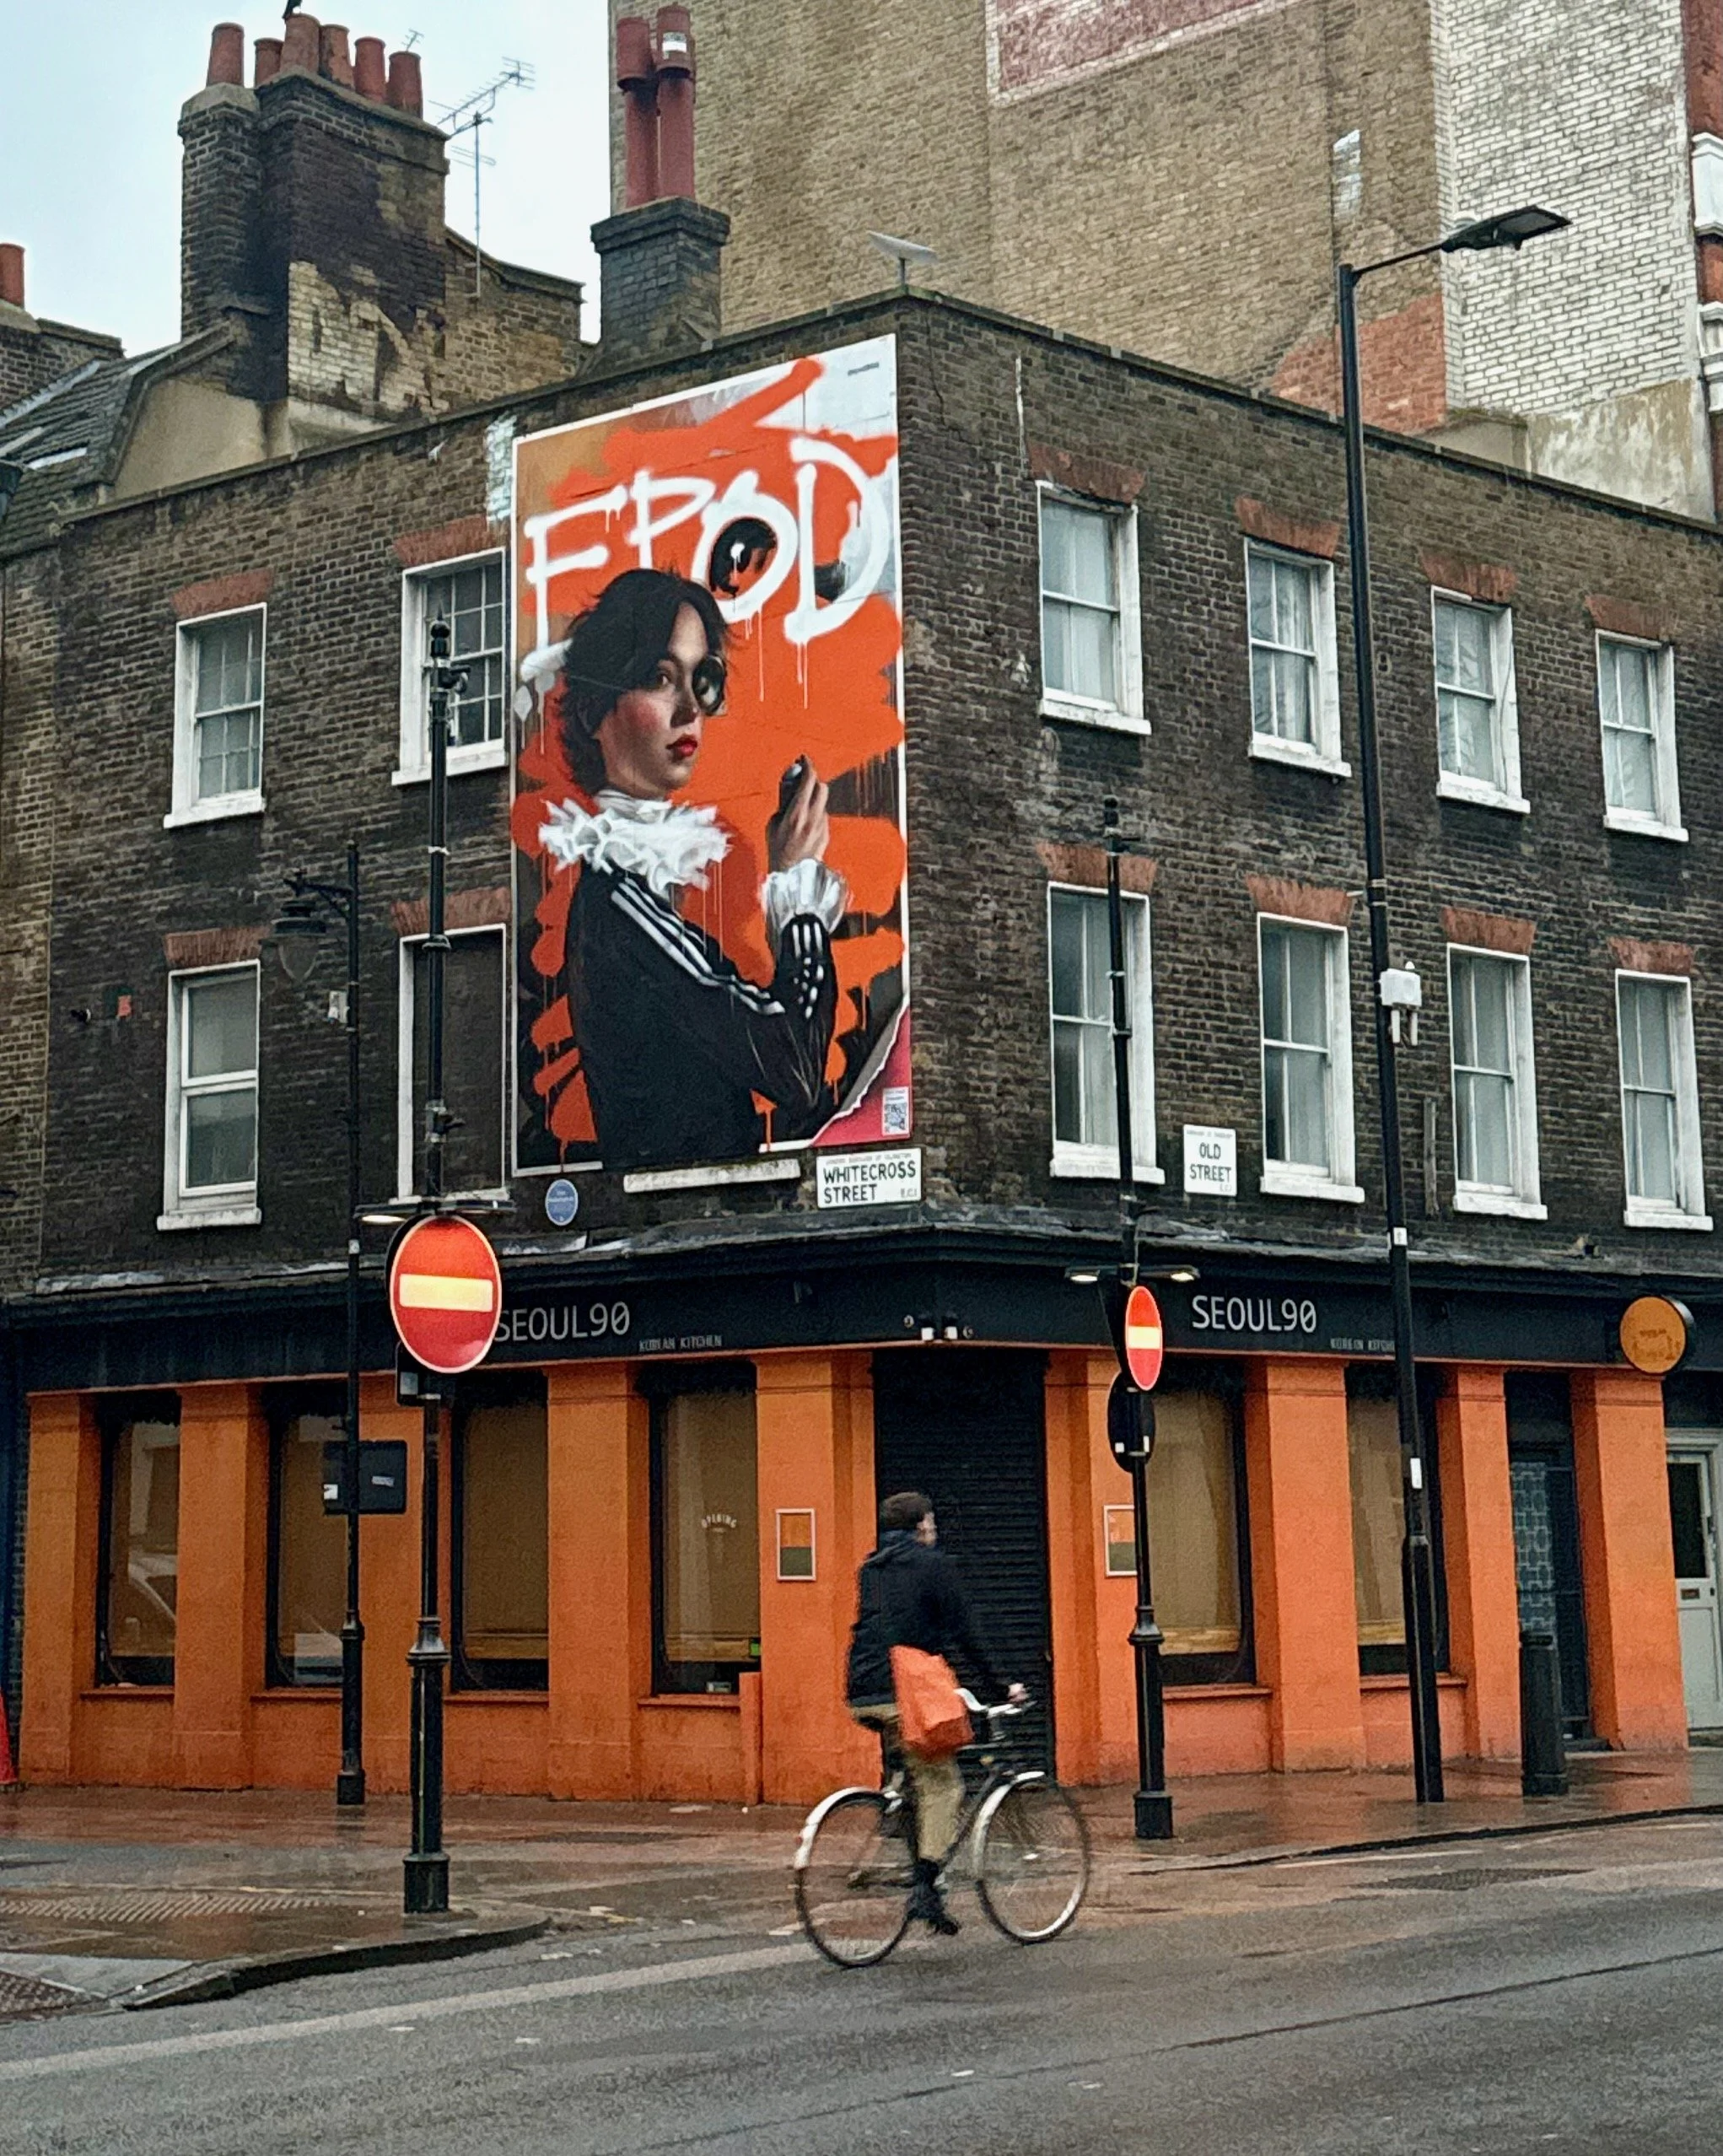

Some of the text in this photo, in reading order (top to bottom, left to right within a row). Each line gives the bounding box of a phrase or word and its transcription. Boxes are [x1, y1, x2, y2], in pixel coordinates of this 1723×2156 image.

[1198, 1141, 1221, 1160] OLD
[822, 1160, 917, 1184] WHITECROSS
[1189, 1163, 1232, 1183] STREET
[823, 1183, 878, 1205] STREET
[494, 1302, 630, 1342] SEOUL90
[1192, 1295, 1317, 1333] SEOUL90
